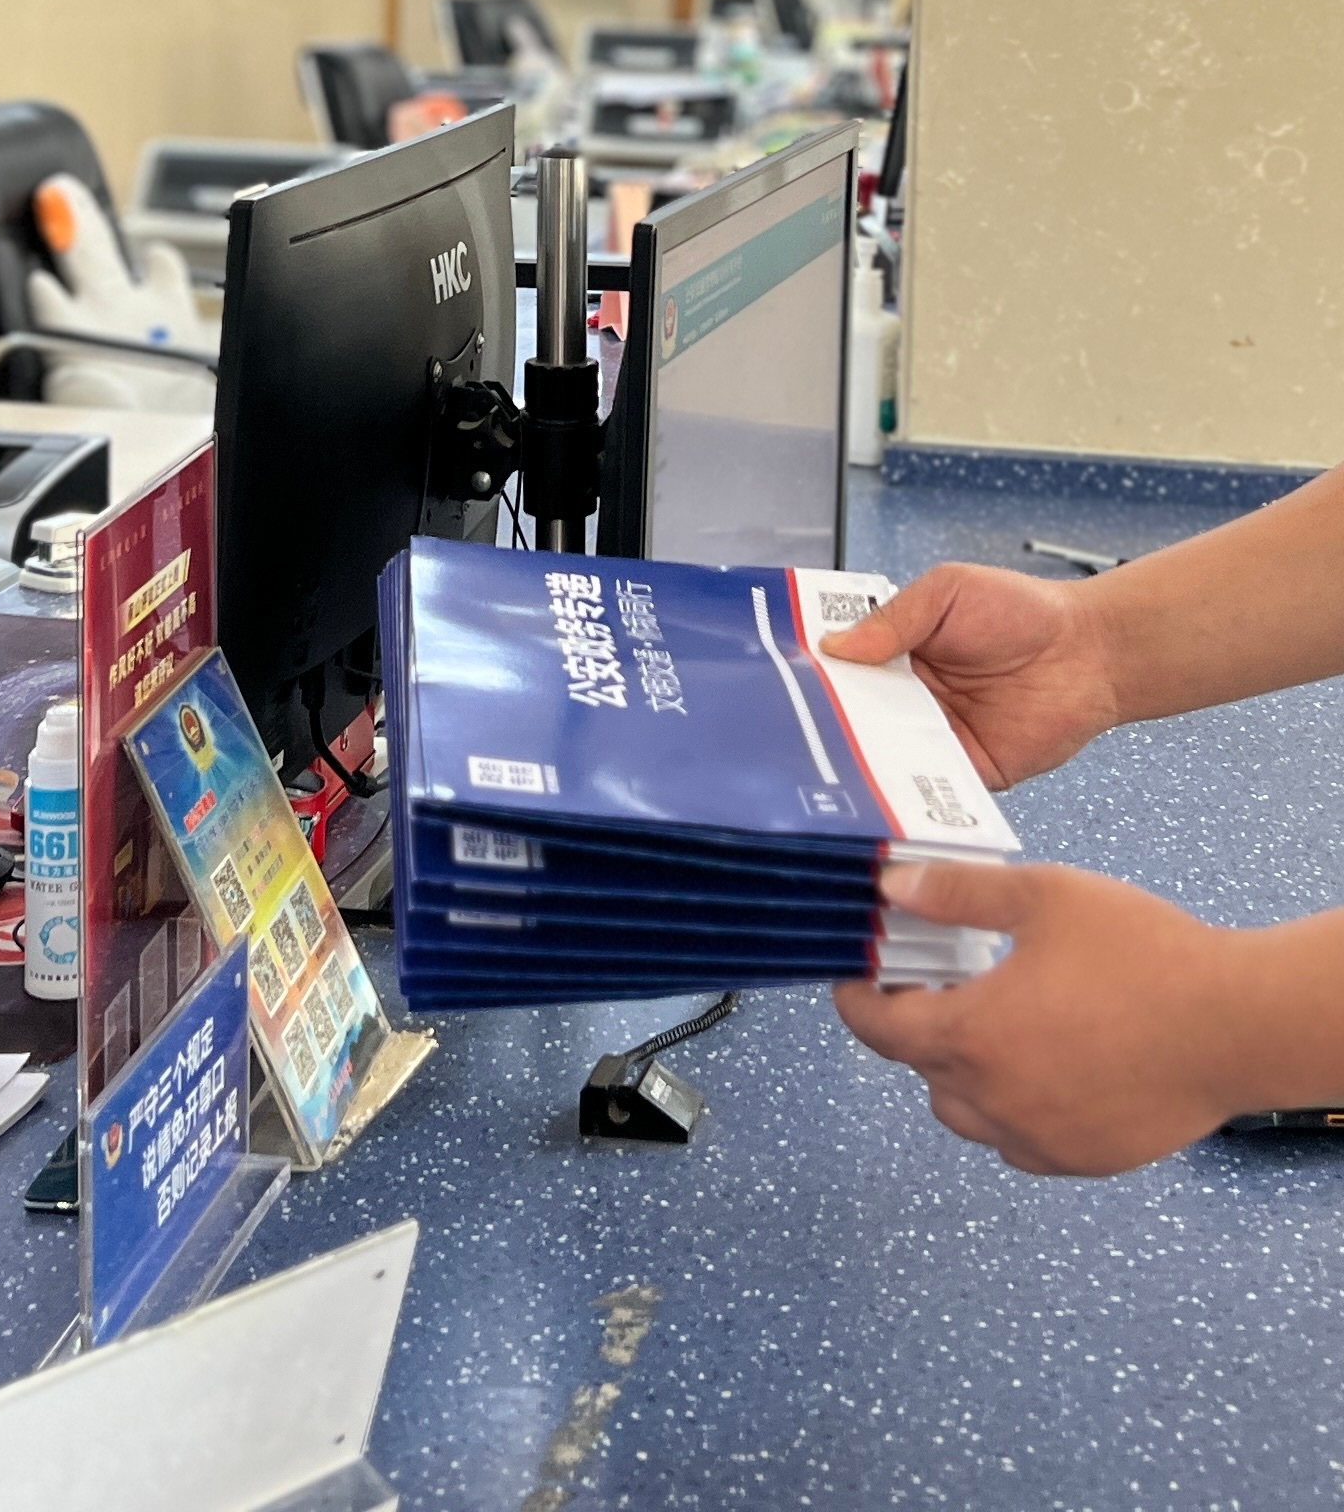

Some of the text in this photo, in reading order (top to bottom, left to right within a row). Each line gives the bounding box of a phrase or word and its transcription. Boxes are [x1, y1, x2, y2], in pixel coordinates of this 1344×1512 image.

[430, 241, 472, 304] HKC
[544, 572, 628, 710] 公安政务专递
[128, 1016, 215, 1155] 严守三个规定
[141, 1054, 225, 1191] 说情免开尊口
[156, 1086, 239, 1229] 否则记录上报
